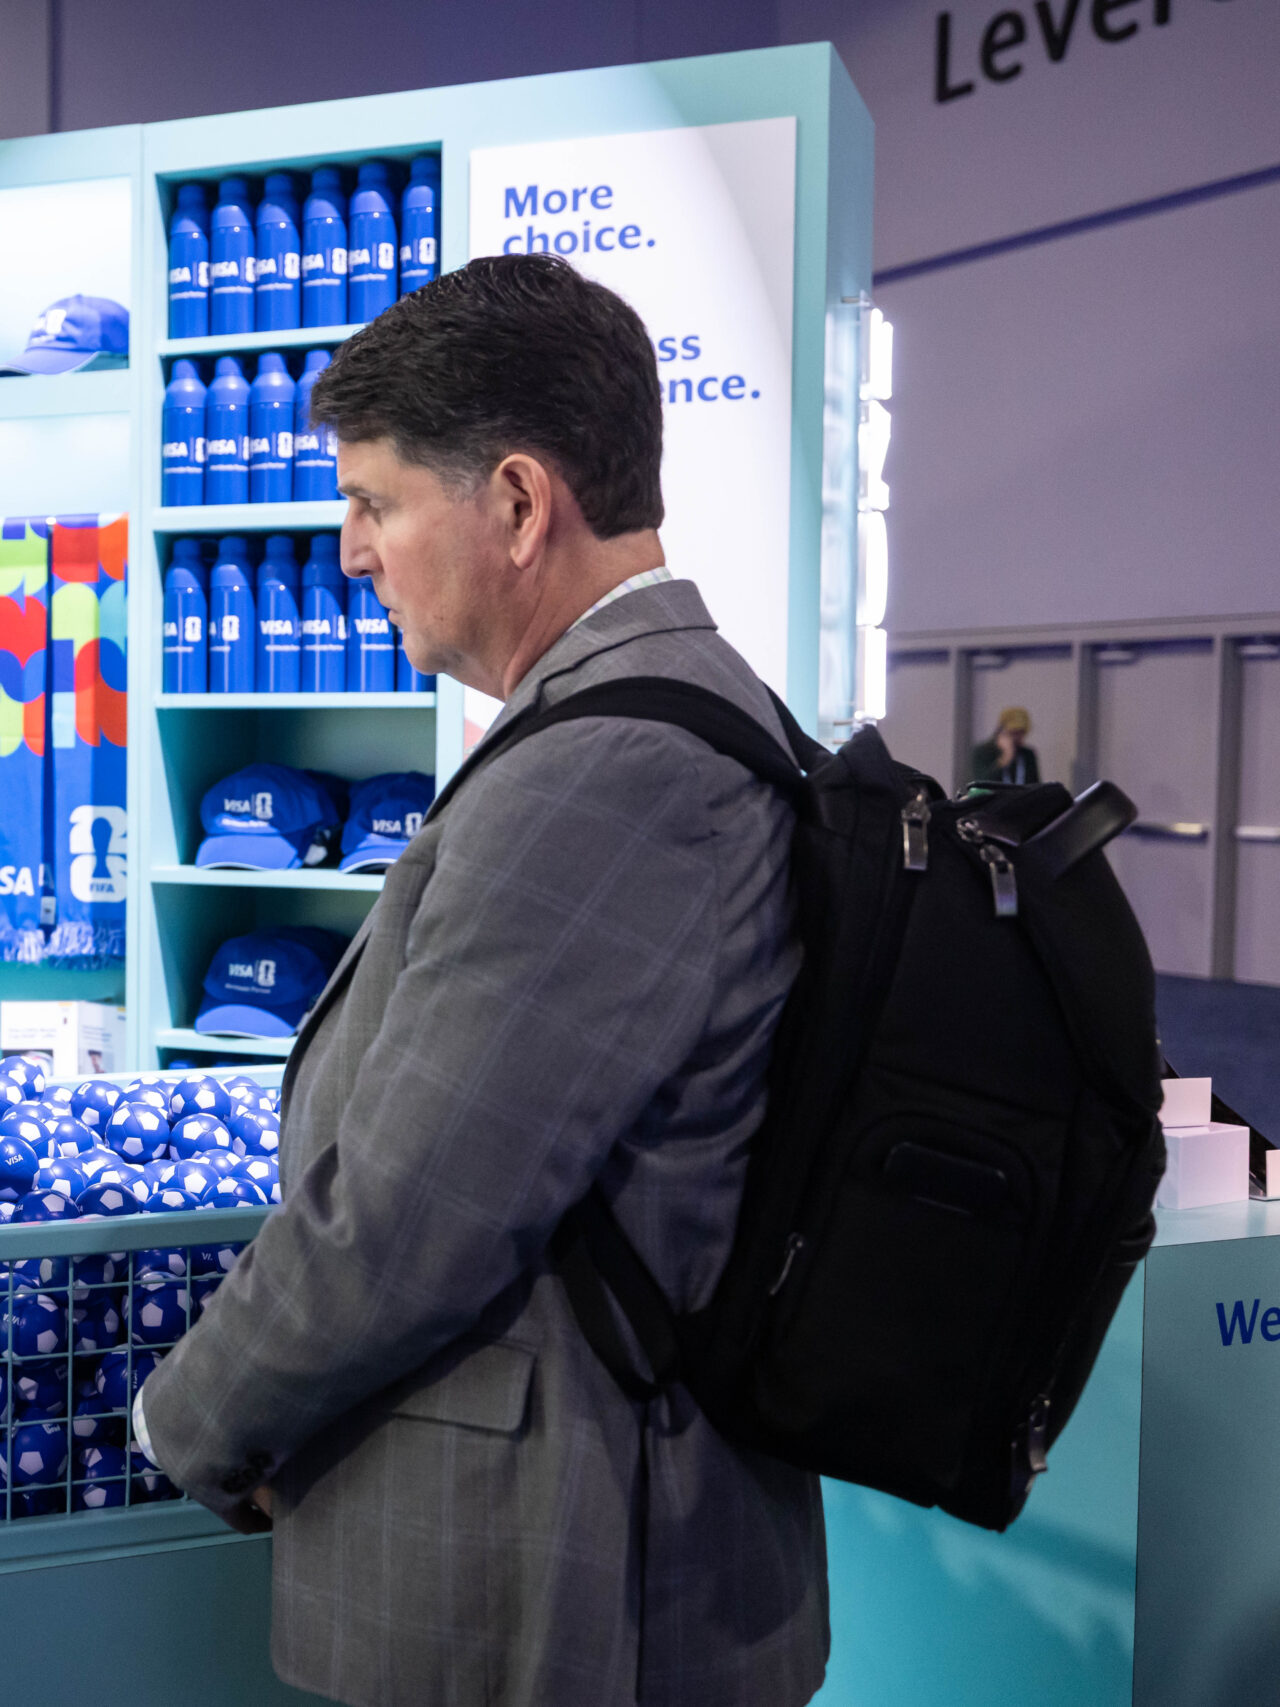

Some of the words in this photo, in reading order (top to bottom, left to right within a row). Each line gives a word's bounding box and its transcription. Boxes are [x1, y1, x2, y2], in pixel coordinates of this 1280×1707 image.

[504, 184, 613, 219] More
[502, 220, 656, 256] choice.
[658, 374, 761, 403] nce.
[355, 618, 389, 634] VISA
[224, 798, 251, 813] VISA
[372, 819, 402, 832] VISA
[89, 883, 116, 894] FIFA
[228, 963, 254, 978] VISA
[4, 1154, 24, 1166] VISA
[1216, 1299, 1280, 1346] We
